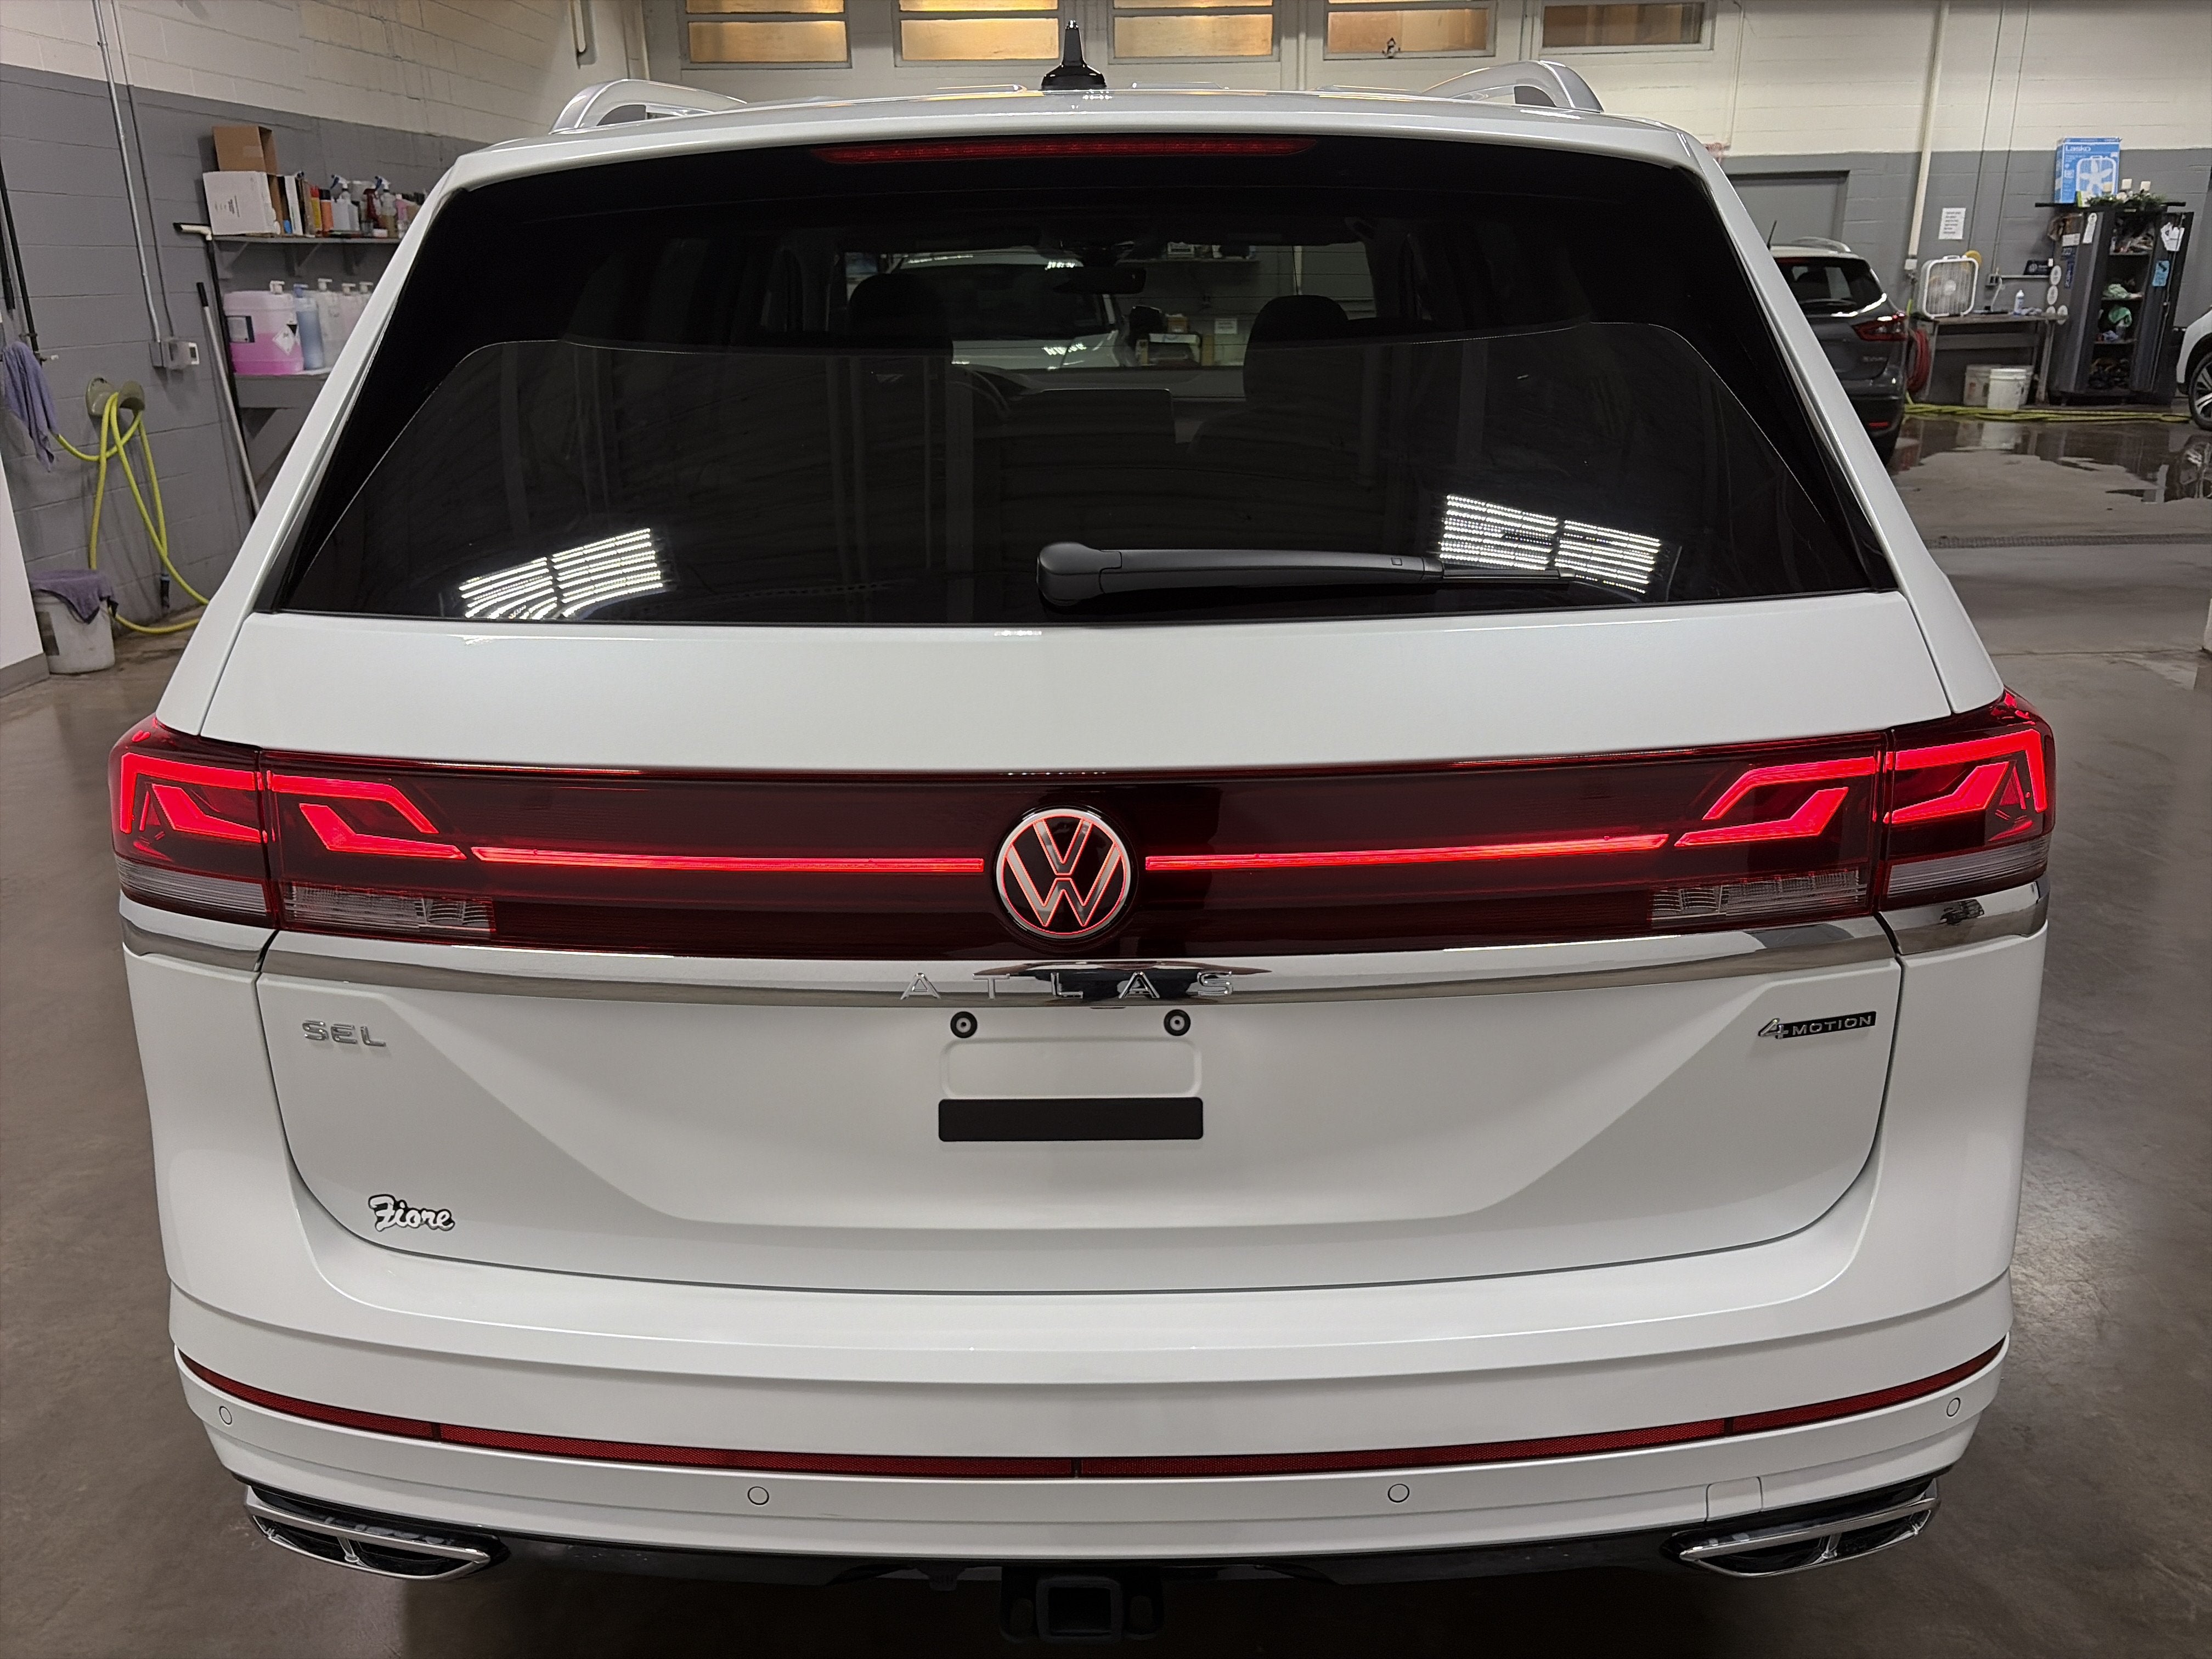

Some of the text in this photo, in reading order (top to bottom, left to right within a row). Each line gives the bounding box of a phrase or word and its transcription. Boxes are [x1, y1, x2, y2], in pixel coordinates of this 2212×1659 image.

[900, 970, 1234, 1000] ATLAS
[302, 1020, 386, 1047] SEL
[368, 1194, 455, 1232] Fiore
